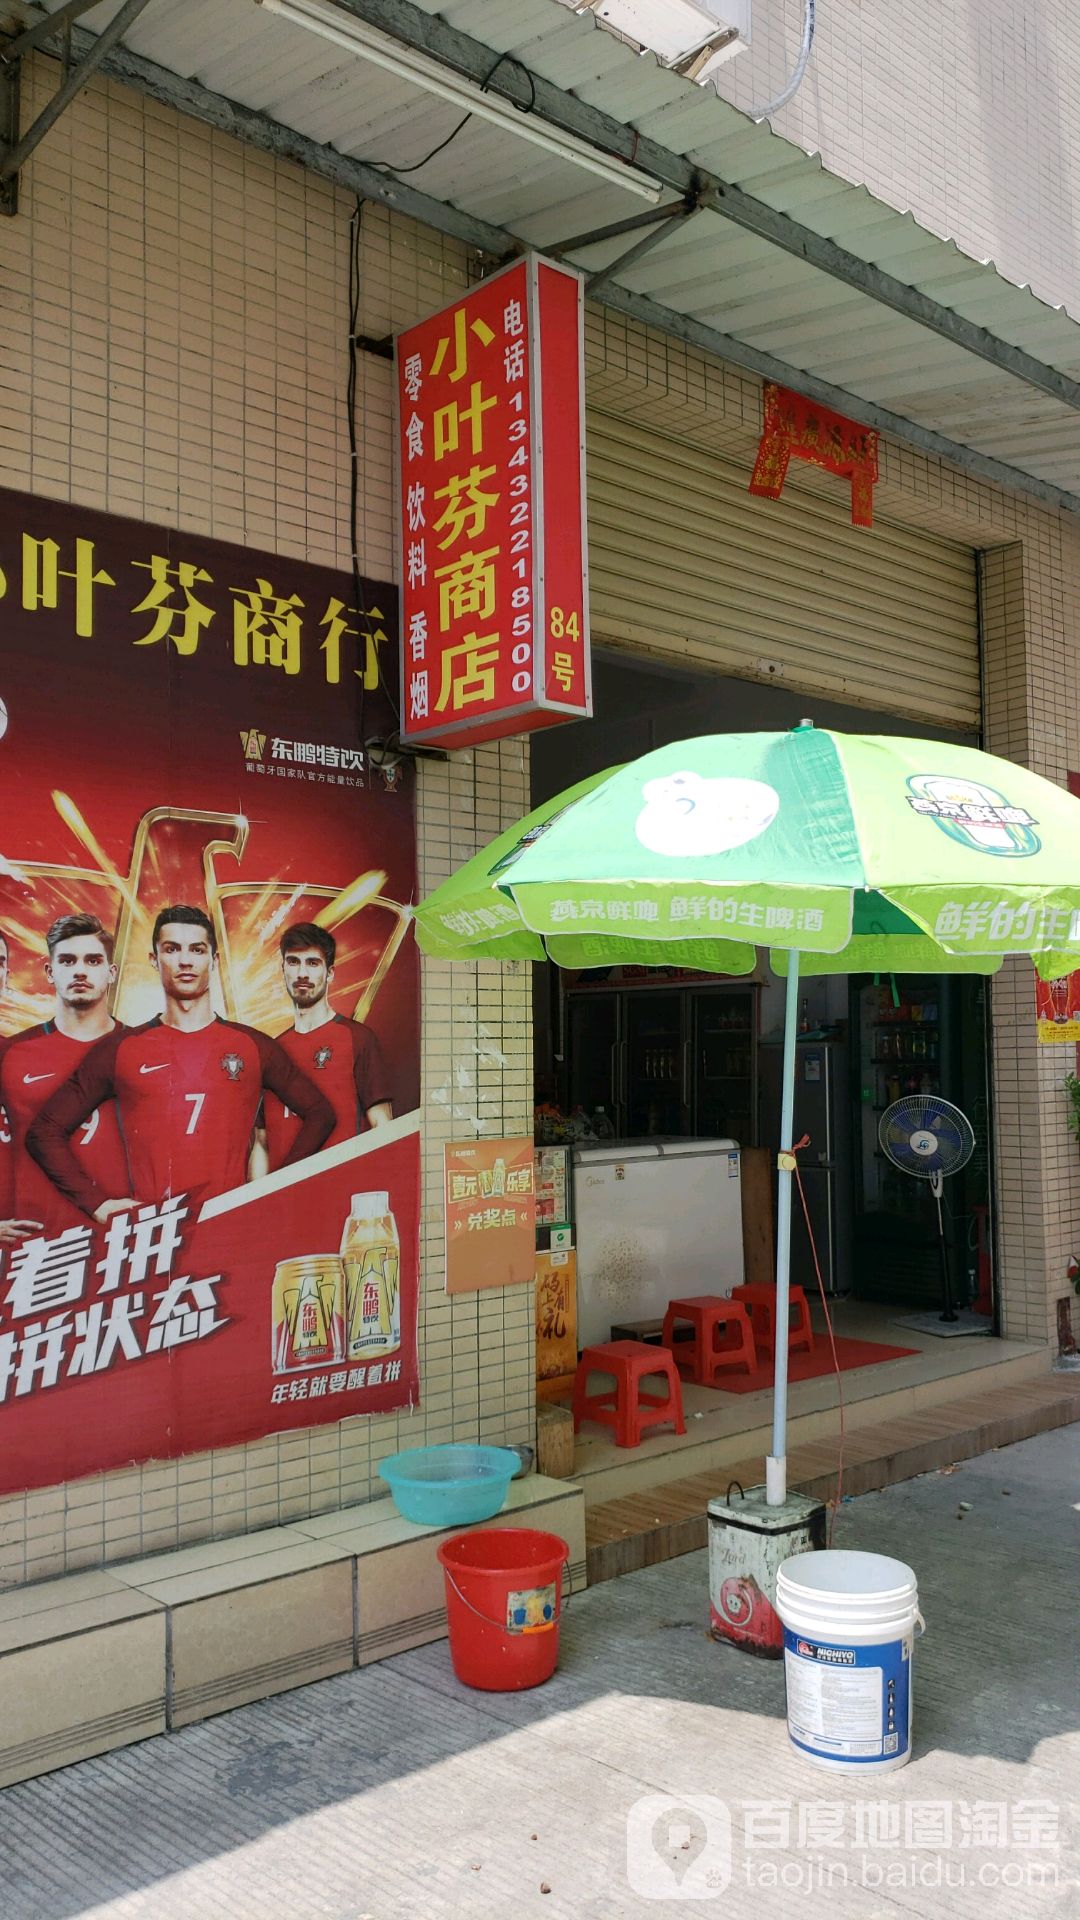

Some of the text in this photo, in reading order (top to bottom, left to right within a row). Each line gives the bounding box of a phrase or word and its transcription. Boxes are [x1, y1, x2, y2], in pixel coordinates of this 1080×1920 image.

[428, 307, 500, 713] 小叶芬商店
[0, 532, 389, 691] 叶芬商行
[271, 737, 365, 772] 东鹏特饮
[245, 762, 365, 788] 葡萄牙国家队官方能量饮品
[669, 896, 824, 932] 鲜的生啤酒
[184, 1093, 206, 1135] 7
[468, 1208, 516, 1231] 兑奖点
[0, 1193, 189, 1319] 着拼
[271, 1360, 401, 1404] 年轻就要醒着拼
[817, 1647, 854, 1659] NICHIYO
